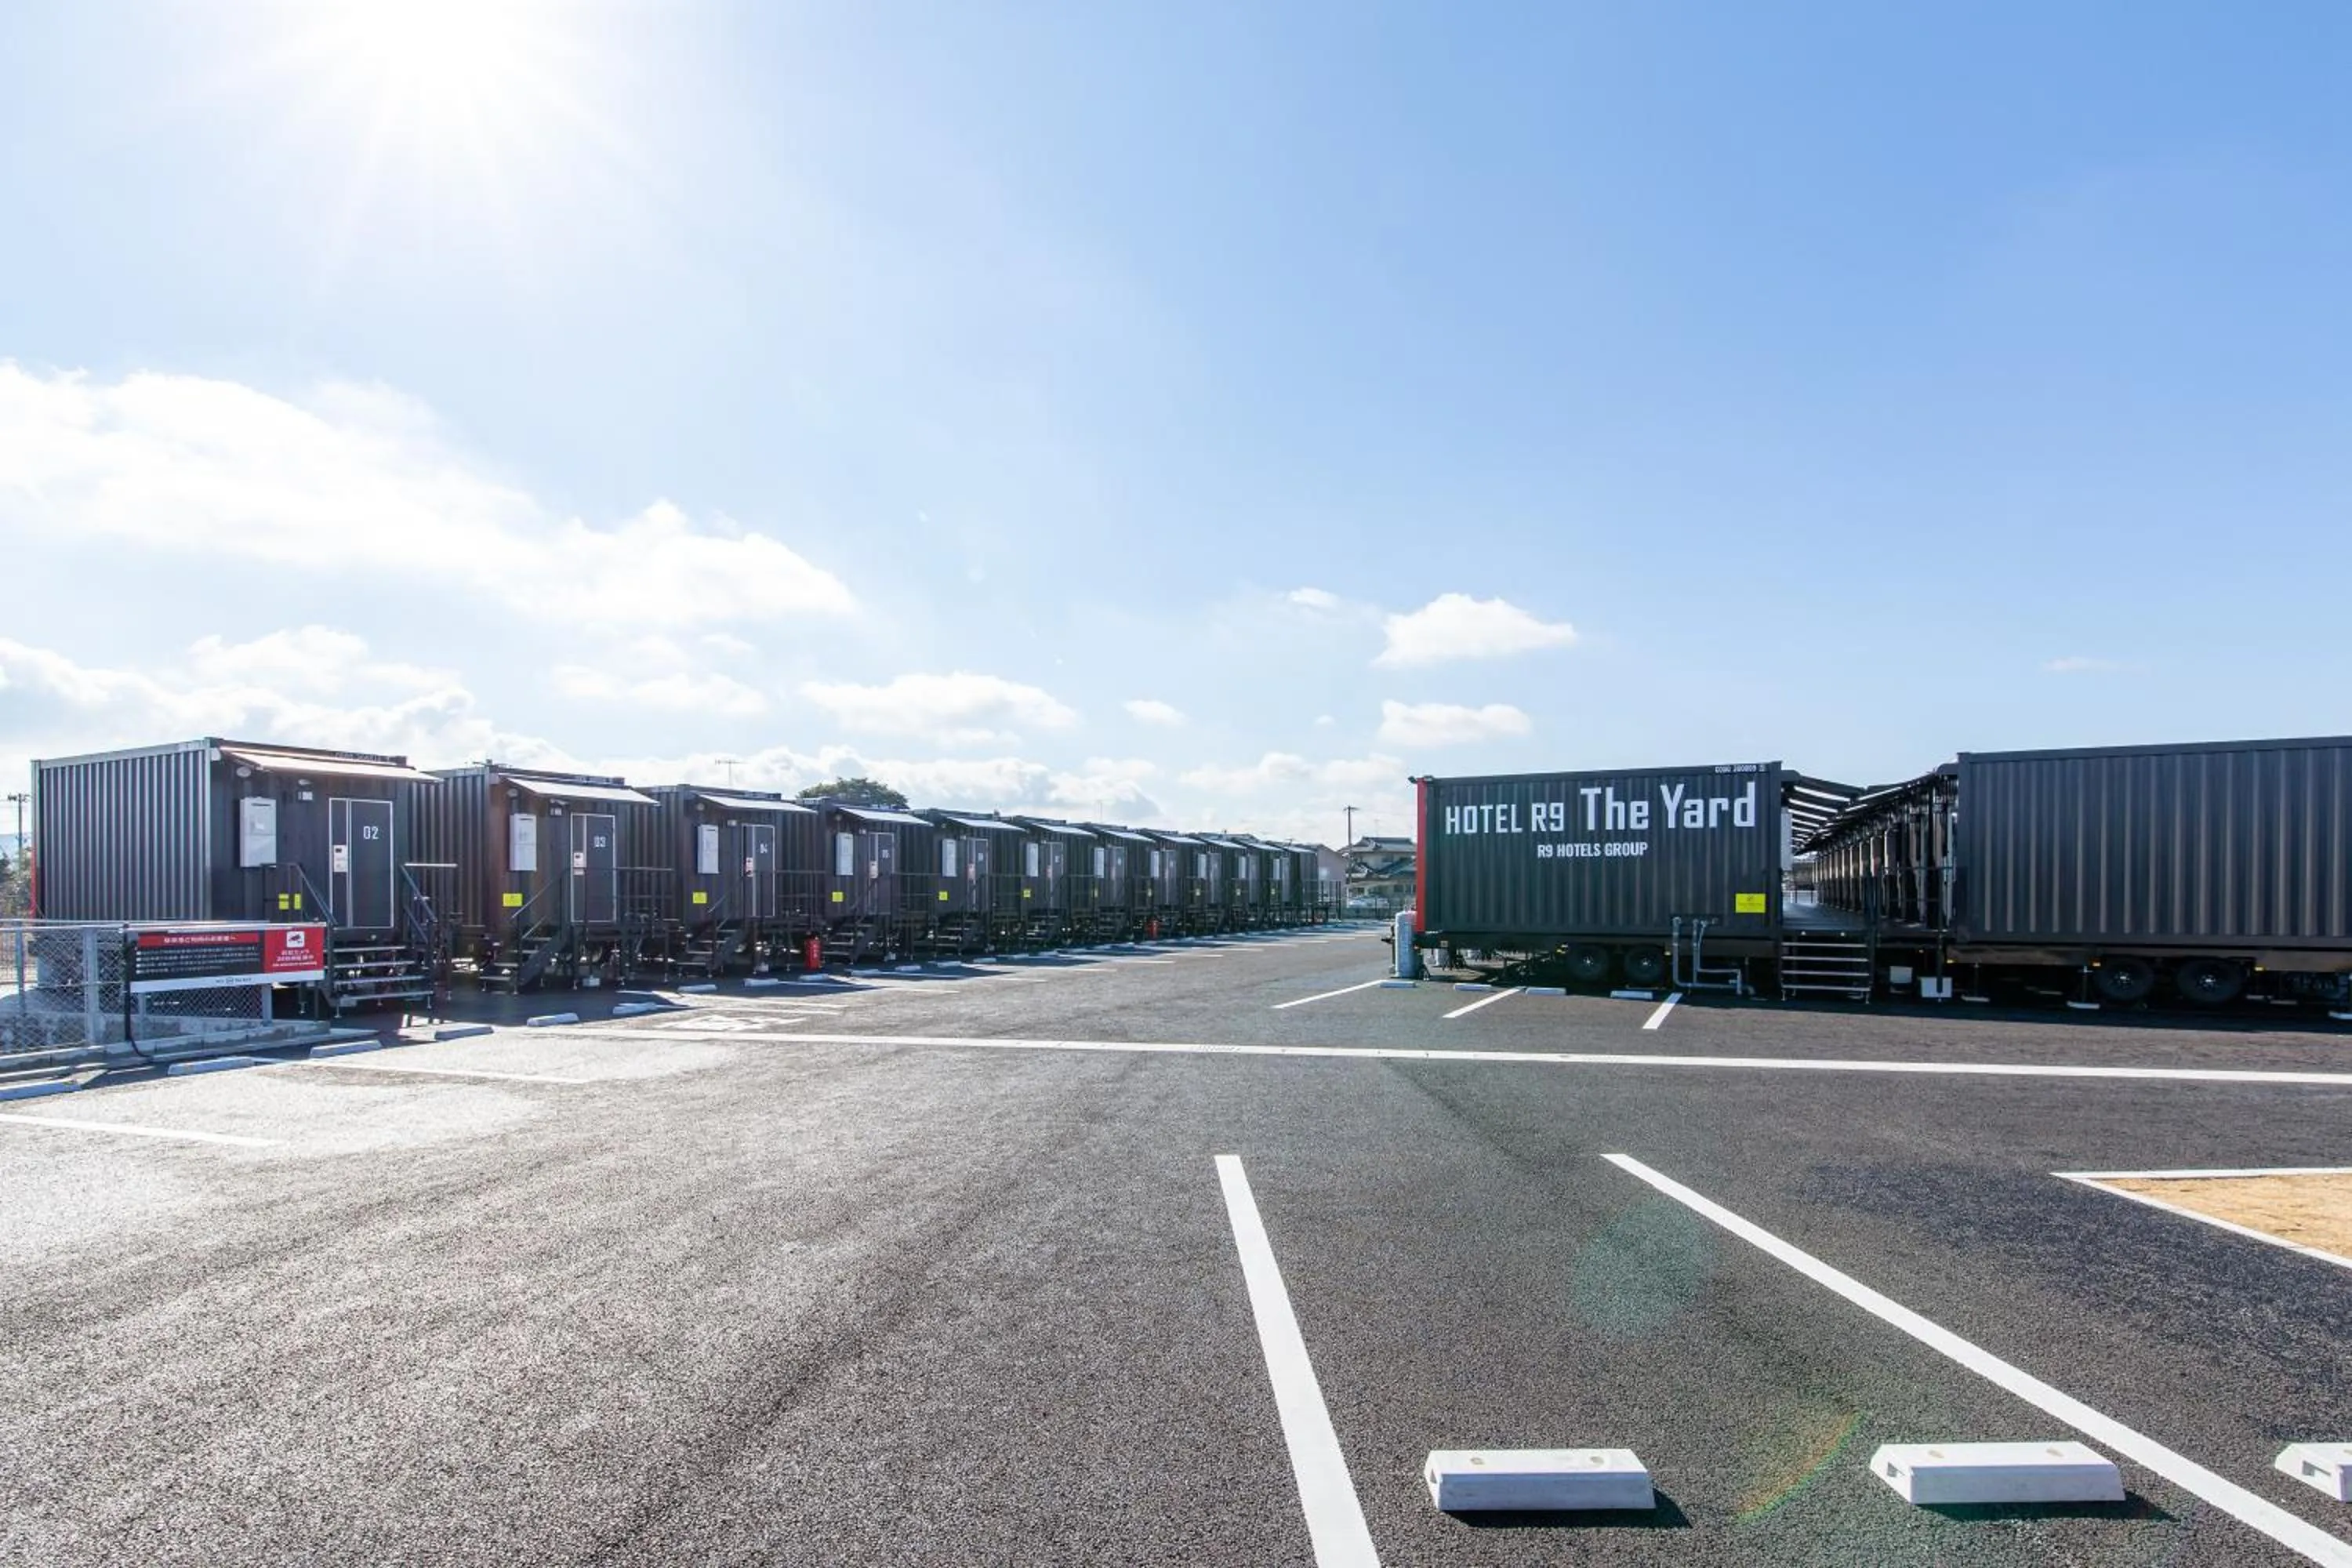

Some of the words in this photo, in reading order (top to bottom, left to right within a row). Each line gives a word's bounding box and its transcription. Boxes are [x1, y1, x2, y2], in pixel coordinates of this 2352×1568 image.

[1445, 804, 1523, 834] HOTEL
[1531, 802, 1564, 832] R9
[1580, 786, 1649, 830] The
[1660, 782, 1755, 829] Yard
[363, 826, 379, 840] 02
[1537, 844, 1553, 858] R9
[1557, 843, 1601, 857] HOTELS
[1604, 841, 1648, 856] GROUP
